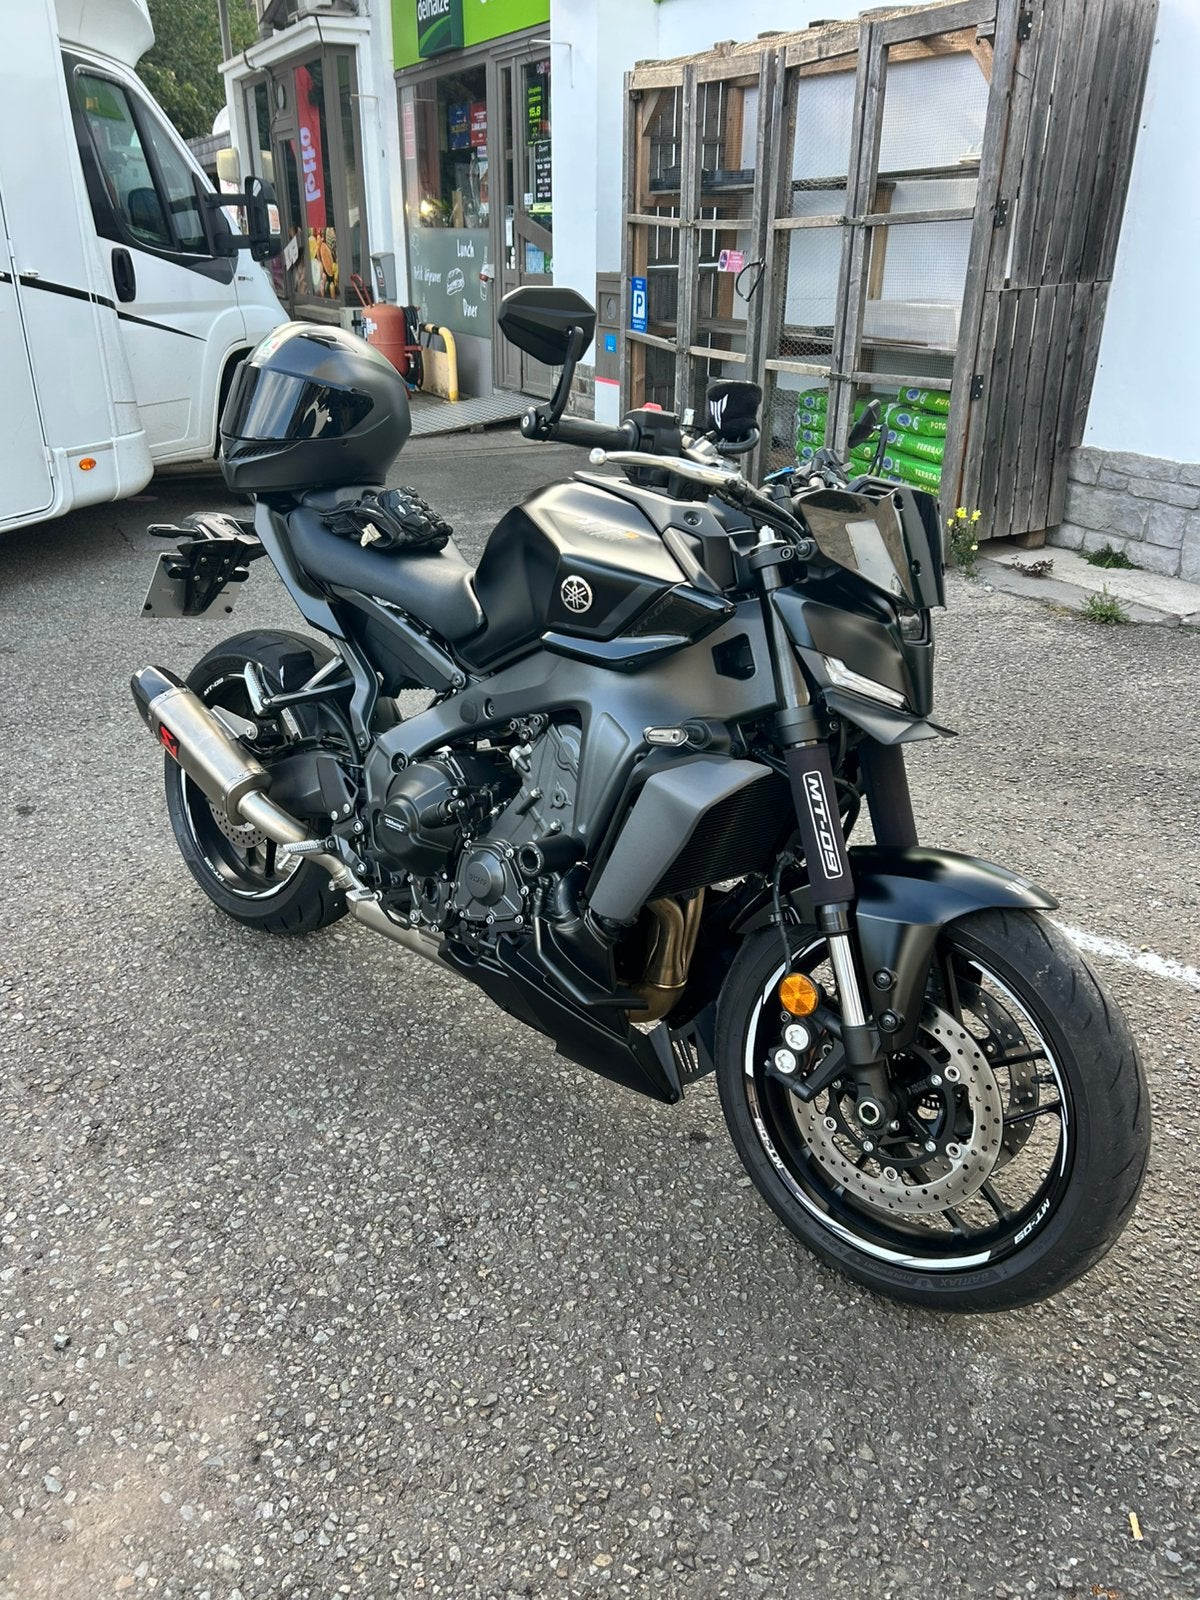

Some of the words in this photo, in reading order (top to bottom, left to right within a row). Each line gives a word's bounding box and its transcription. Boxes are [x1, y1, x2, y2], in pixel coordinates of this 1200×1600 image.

[456, 239, 475, 258] Lunch
[635, 293, 644, 315] P
[807, 777, 840, 873] MT-09
[1014, 1198, 1050, 1244] MT-09
